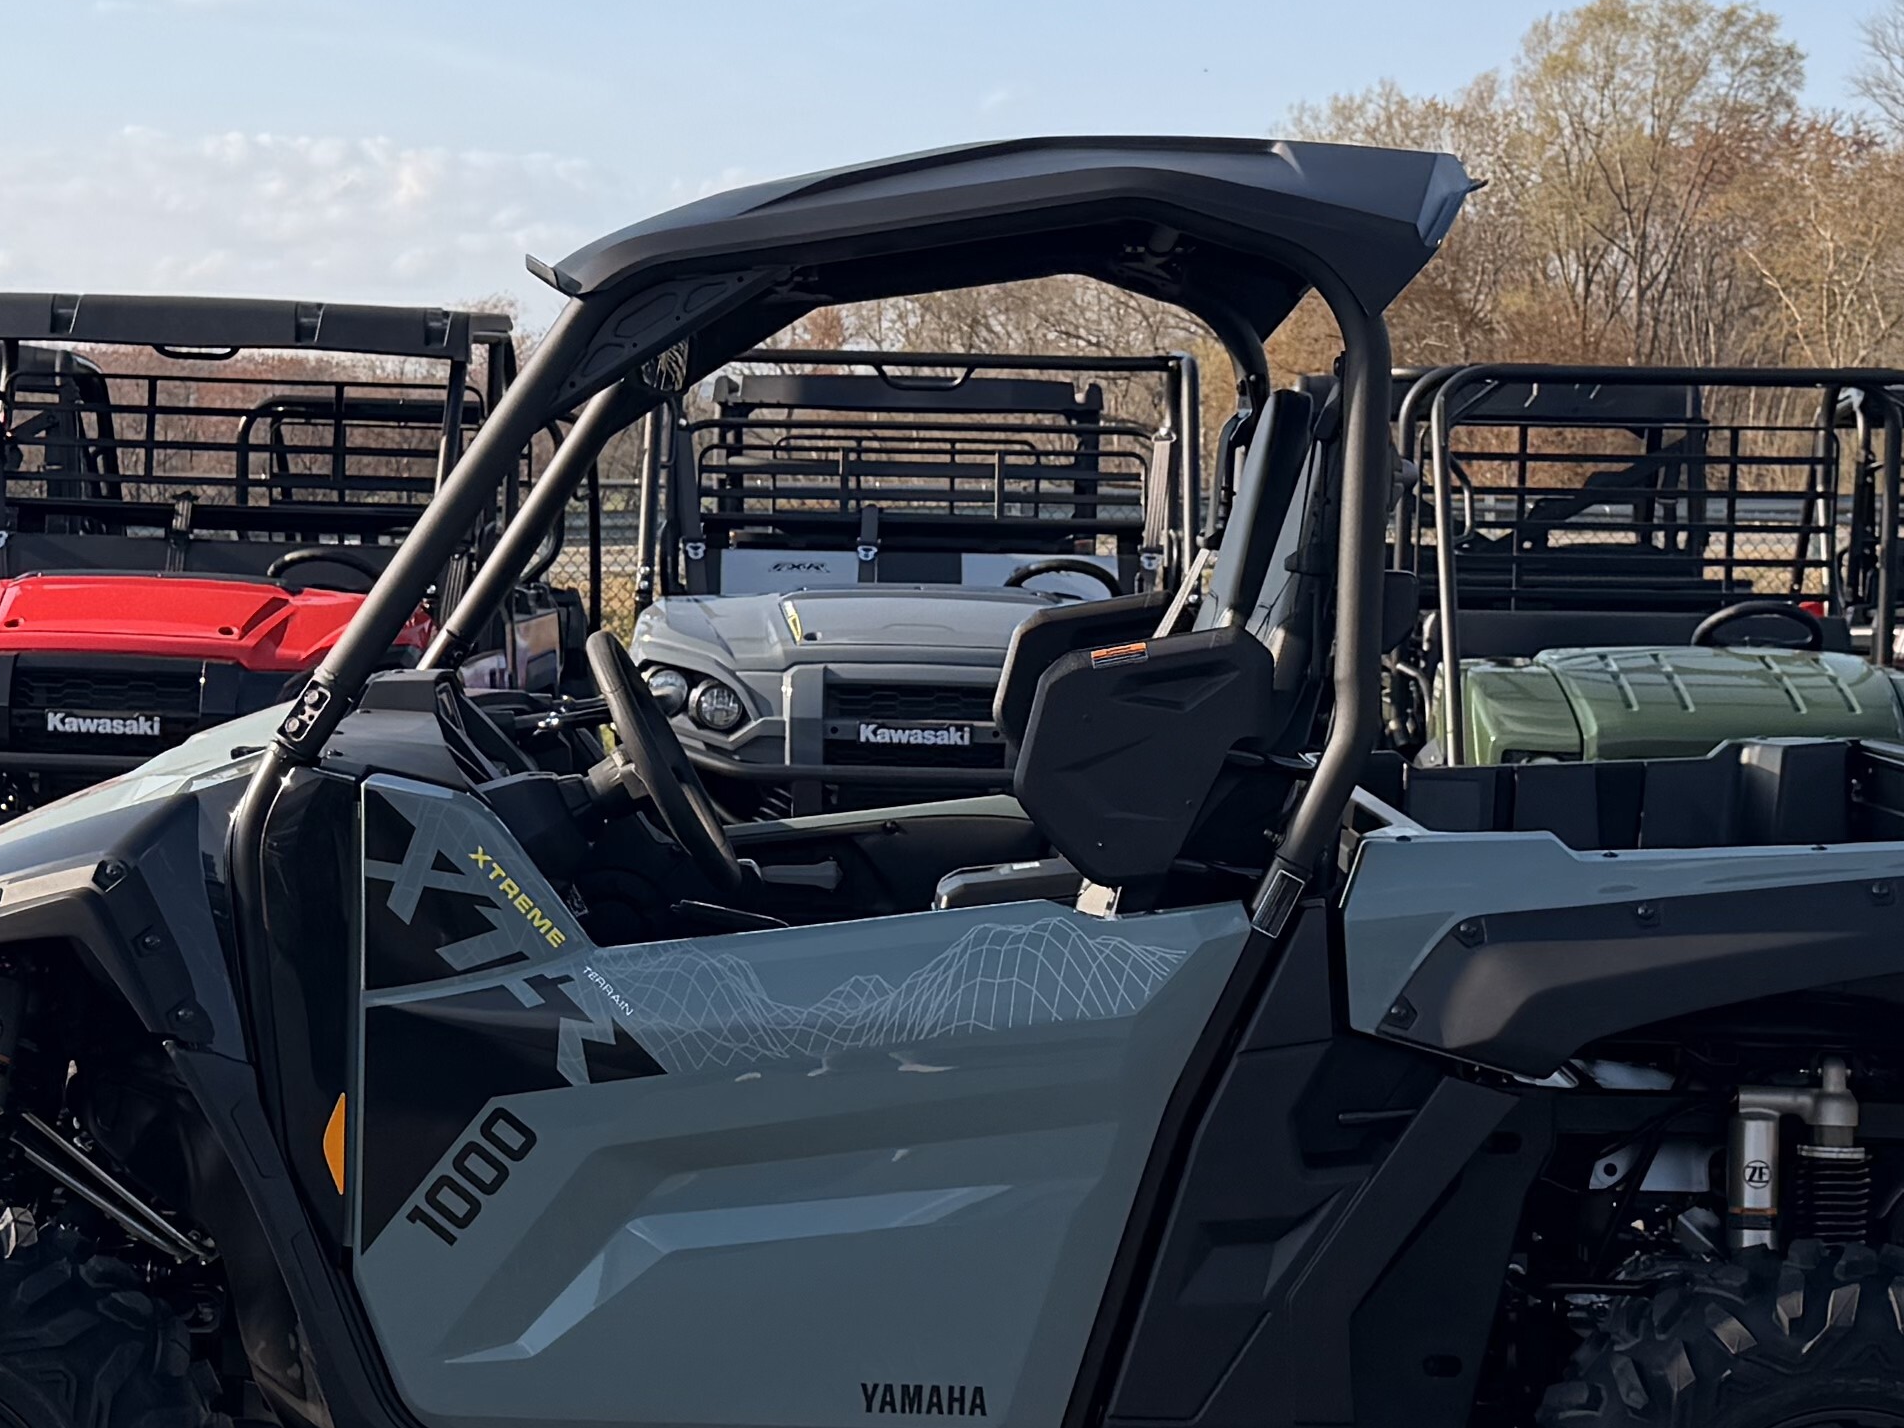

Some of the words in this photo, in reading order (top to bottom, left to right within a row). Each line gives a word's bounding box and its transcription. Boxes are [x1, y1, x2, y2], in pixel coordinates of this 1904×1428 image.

[46, 712, 162, 736] Kawasaki
[860, 723, 971, 746] Kawasaki
[468, 845, 567, 948] XTREME
[583, 965, 634, 1016] TERRAIN
[406, 1107, 537, 1247] 1000
[1745, 1166, 1771, 1184] ZF
[860, 1382, 987, 1417] YAMAHA
